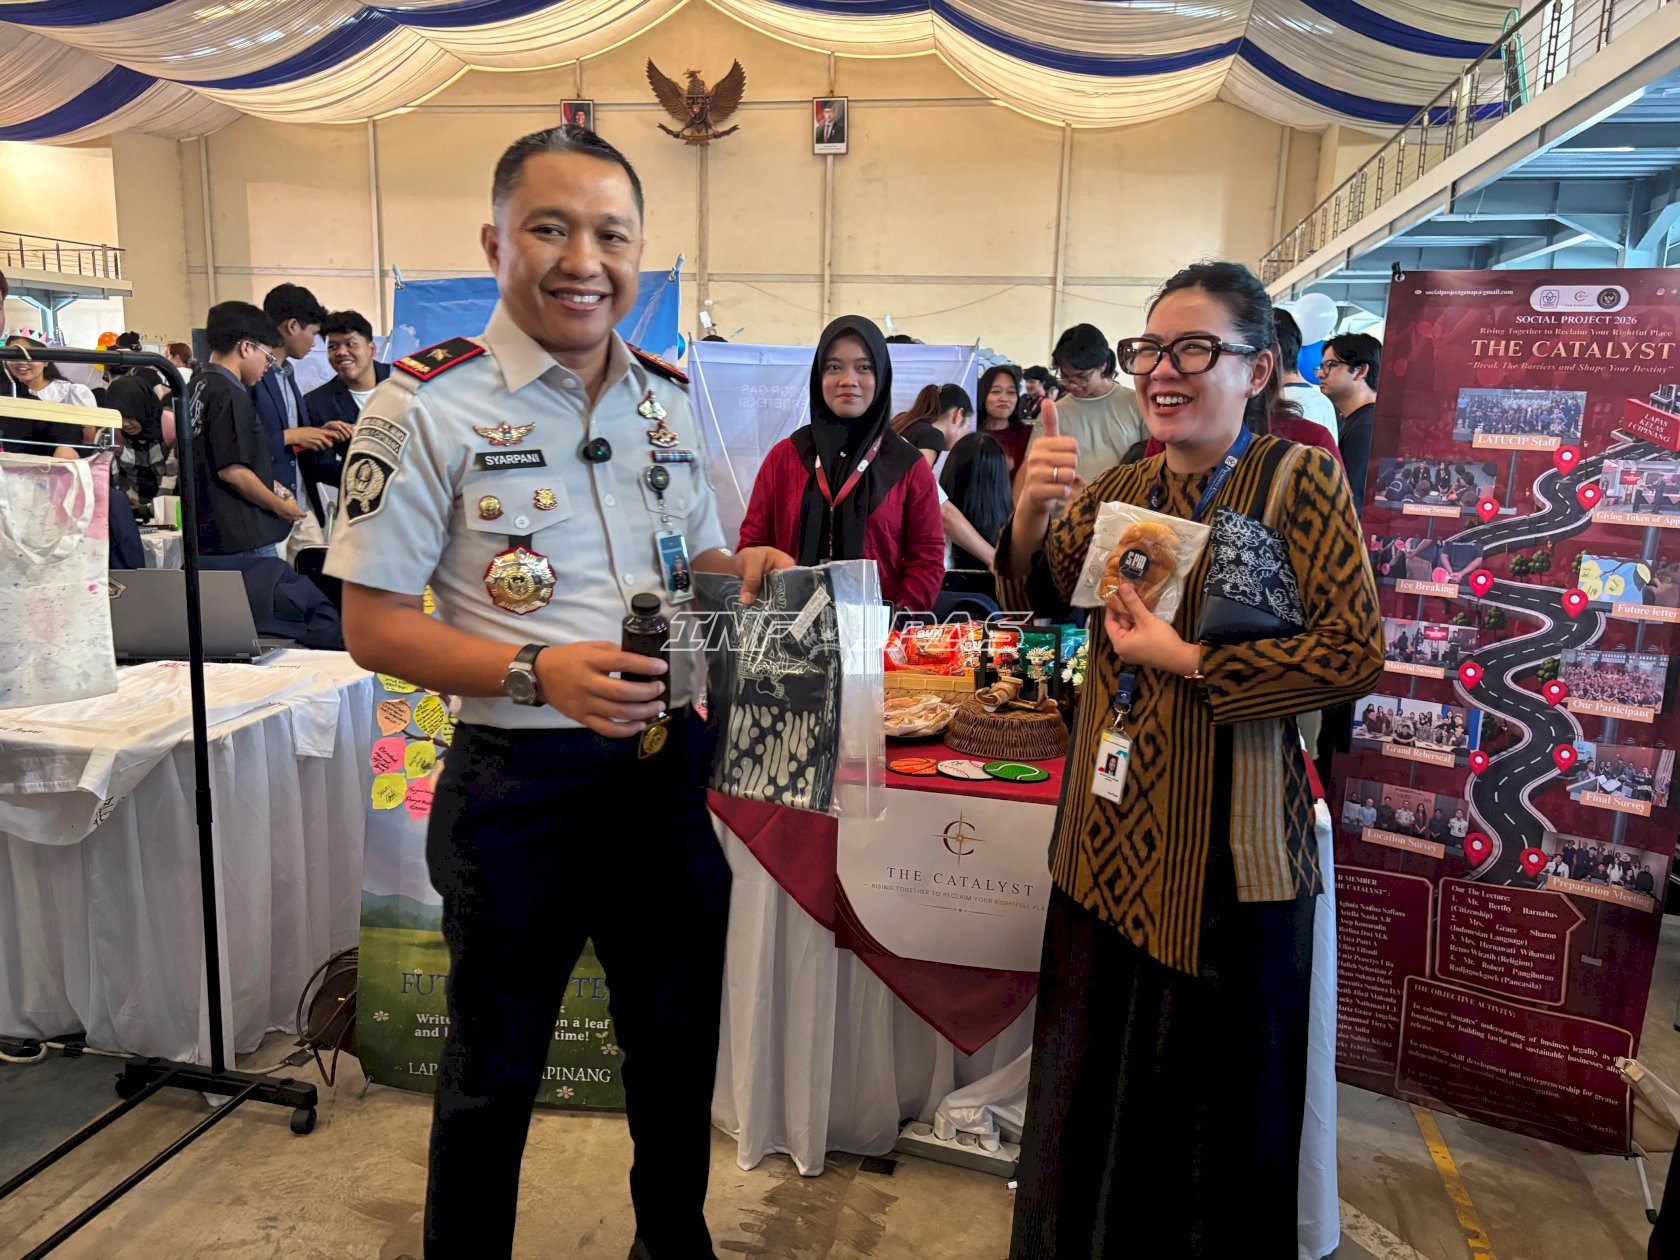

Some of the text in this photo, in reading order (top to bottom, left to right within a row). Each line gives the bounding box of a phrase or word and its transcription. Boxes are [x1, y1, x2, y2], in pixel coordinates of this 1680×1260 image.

[1515, 315, 1637, 325] SOCIAL PROJECT 2026
[1480, 327, 1505, 335] Rising
[1508, 327, 1541, 336] Together
[1555, 327, 1588, 335] Reclaim
[1590, 328, 1610, 336] Your
[1612, 329, 1647, 337] Rightful
[1650, 329, 1673, 337] Place
[1471, 339, 1676, 360] THE CATALYST
[1521, 362, 1556, 370] Barriers
[1577, 363, 1606, 373] Shape
[1609, 364, 1630, 372] Your
[1639, 419, 1665, 433] KELAS
[1644, 413, 1668, 427] LAPAS
[1632, 423, 1670, 443] CIPINANG
[1478, 435, 1557, 447] LATUCIP Staff
[485, 453, 541, 466] SYARPANI
[1407, 505, 1457, 514] Sharing Session
[1596, 512, 1623, 521] Giving
[1626, 513, 1650, 522] Token
[1651, 515, 1662, 523] of
[1400, 581, 1455, 595] Ice Breaking
[1617, 603, 1678, 618] Future letter
[1386, 661, 1442, 675] Material Session
[1572, 699, 1650, 718] Our Participant
[1386, 744, 1411, 755] Grand
[1586, 792, 1646, 812] Final Survey
[1367, 829, 1437, 853] Location Survey
[886, 866, 1034, 897] THE CATALYST
[1552, 876, 1610, 897] Preparation
[871, 883, 894, 891] RISING
[895, 885, 930, 895] TOGETHER
[942, 891, 972, 901] RECLAIM
[974, 896, 993, 905] YOUR
[1451, 884, 1511, 902] Our The Lecture:
[1450, 904, 1493, 920] (Citizenship)
[1488, 901, 1512, 914] Berthy
[1449, 924, 1528, 946] (Indonesian Language)
[1495, 923, 1519, 934] Grace
[1529, 929, 1557, 940] Sharon
[1479, 940, 1516, 954] Hernawati
[1481, 961, 1505, 973] Robert
[1497, 954, 1534, 968] (Religion)
[1500, 976, 1542, 991] (Pancasila)
[1414, 983, 1429, 993] THE
[1430, 987, 1477, 1006] OBJECTIVE
[572, 1019, 580, 1028] a
[584, 1017, 611, 1029] leaf
[414, 1027, 589, 1041] and time!
[1480, 1021, 1526, 1042] understanding
[1528, 1036, 1538, 1044] of
[1540, 1037, 1570, 1051] business
[1572, 1044, 1599, 1058] legality
[1601, 1052, 1611, 1061] as
[1458, 1024, 1486, 1039] building
[1509, 1041, 1523, 1050] and
[1525, 1046, 1565, 1060] sustainable
[1567, 1053, 1604, 1069] businesses
[1466, 1056, 1507, 1075] development
[1582, 1087, 1594, 1097] for
[1594, 1093, 1620, 1107] greater
